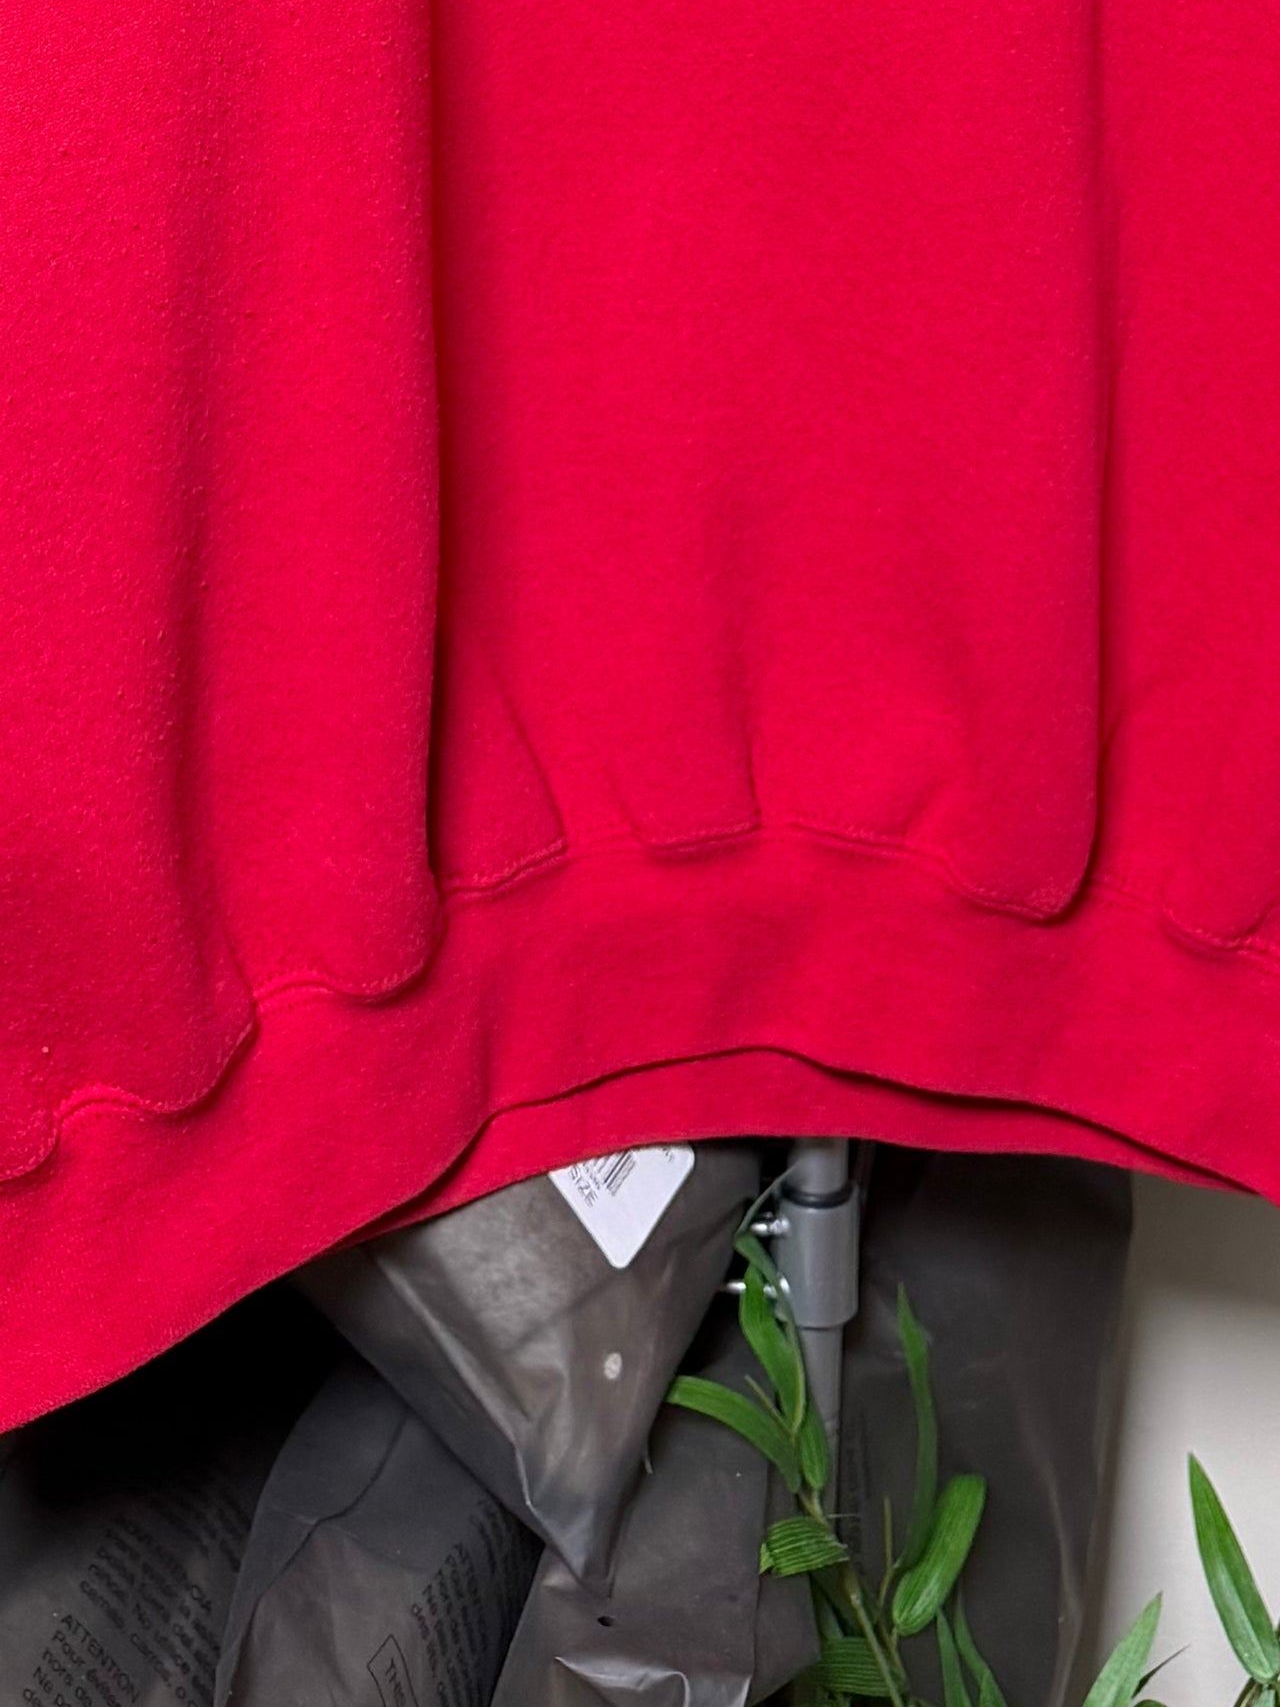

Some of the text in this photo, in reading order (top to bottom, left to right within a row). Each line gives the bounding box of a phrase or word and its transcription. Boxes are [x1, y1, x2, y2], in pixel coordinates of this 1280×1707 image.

[51, 1629, 87, 1667] Pour
[60, 1613, 141, 1704] ATTENTION
[32, 1666, 56, 1695] Ne
[175, 1686, 187, 1700] o
